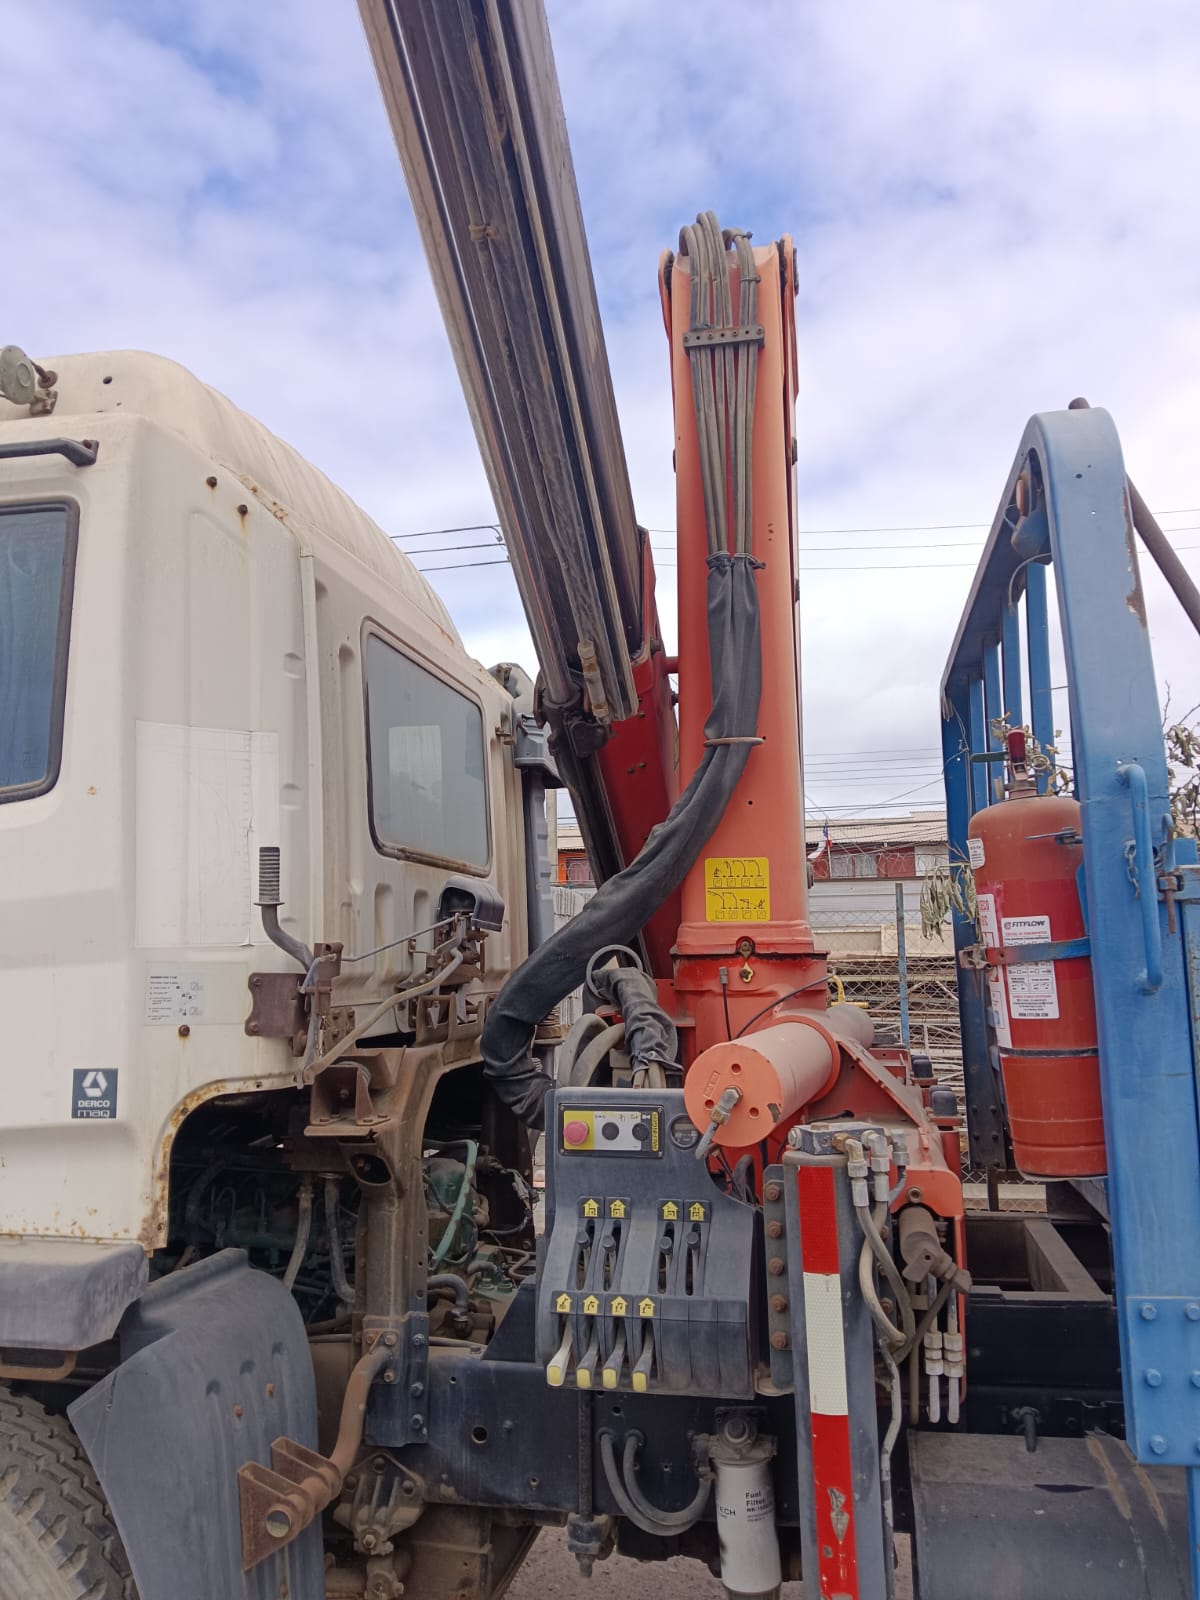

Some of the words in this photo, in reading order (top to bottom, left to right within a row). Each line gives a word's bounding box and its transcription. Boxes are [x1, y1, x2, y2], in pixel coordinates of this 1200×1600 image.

[1012, 920, 1046, 928] FITFLOW
[78, 1100, 110, 1108] DERCO
[746, 1490, 761, 1499] Fuel
[746, 1498, 765, 1507] Filter
